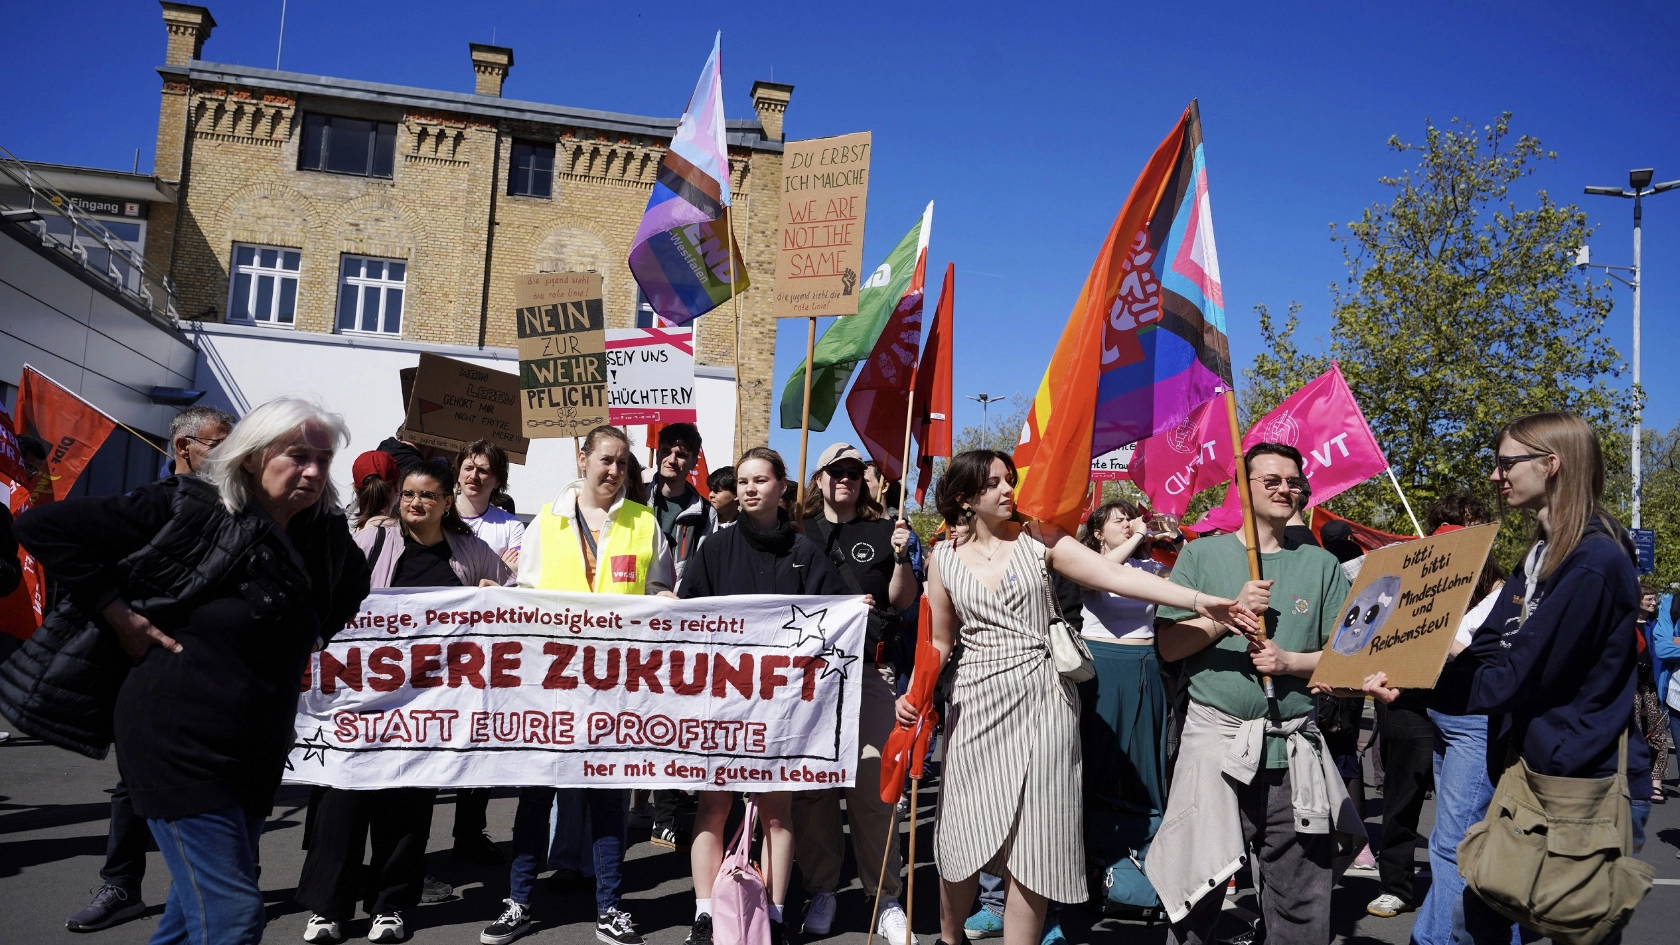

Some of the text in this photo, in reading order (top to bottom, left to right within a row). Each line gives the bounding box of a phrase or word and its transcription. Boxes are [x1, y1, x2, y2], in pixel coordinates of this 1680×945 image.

[790, 143, 869, 169] DU ERBST
[785, 169, 866, 192] ICH MALOCHE
[71, 197, 118, 214] Eingang
[789, 196, 858, 222] WE ARE
[784, 223, 855, 249] NOT THE
[666, 230, 709, 284] -Westfalen
[790, 250, 847, 276] SAME
[533, 292, 544, 300] die
[548, 290, 564, 299] rote
[777, 291, 788, 301] die
[790, 291, 810, 304] jugend
[830, 290, 840, 299] die
[793, 303, 809, 311] rote
[523, 301, 591, 334] NEIN
[541, 336, 581, 356] ZUR
[641, 350, 669, 363] UNS
[459, 368, 488, 382] MEIN
[530, 357, 602, 383] WEHR
[478, 403, 495, 415] MIR
[526, 384, 605, 409] PFLICHT
[454, 411, 511, 431] NICHT FRITZE
[1402, 544, 1435, 570] bitti
[1420, 553, 1451, 578] bitti
[1398, 571, 1474, 609] Mindestlohni
[1411, 598, 1434, 617] und
[425, 606, 623, 634] Perspektivlosigkeit
[649, 618, 673, 632] es
[680, 615, 745, 635] reicht!
[541, 641, 827, 702] ZUKUNFT
[333, 709, 767, 753] STATT EURE PROFITE
[583, 760, 616, 777] her
[624, 759, 657, 777] mit
[664, 760, 706, 780] dem
[714, 765, 773, 786] guten
